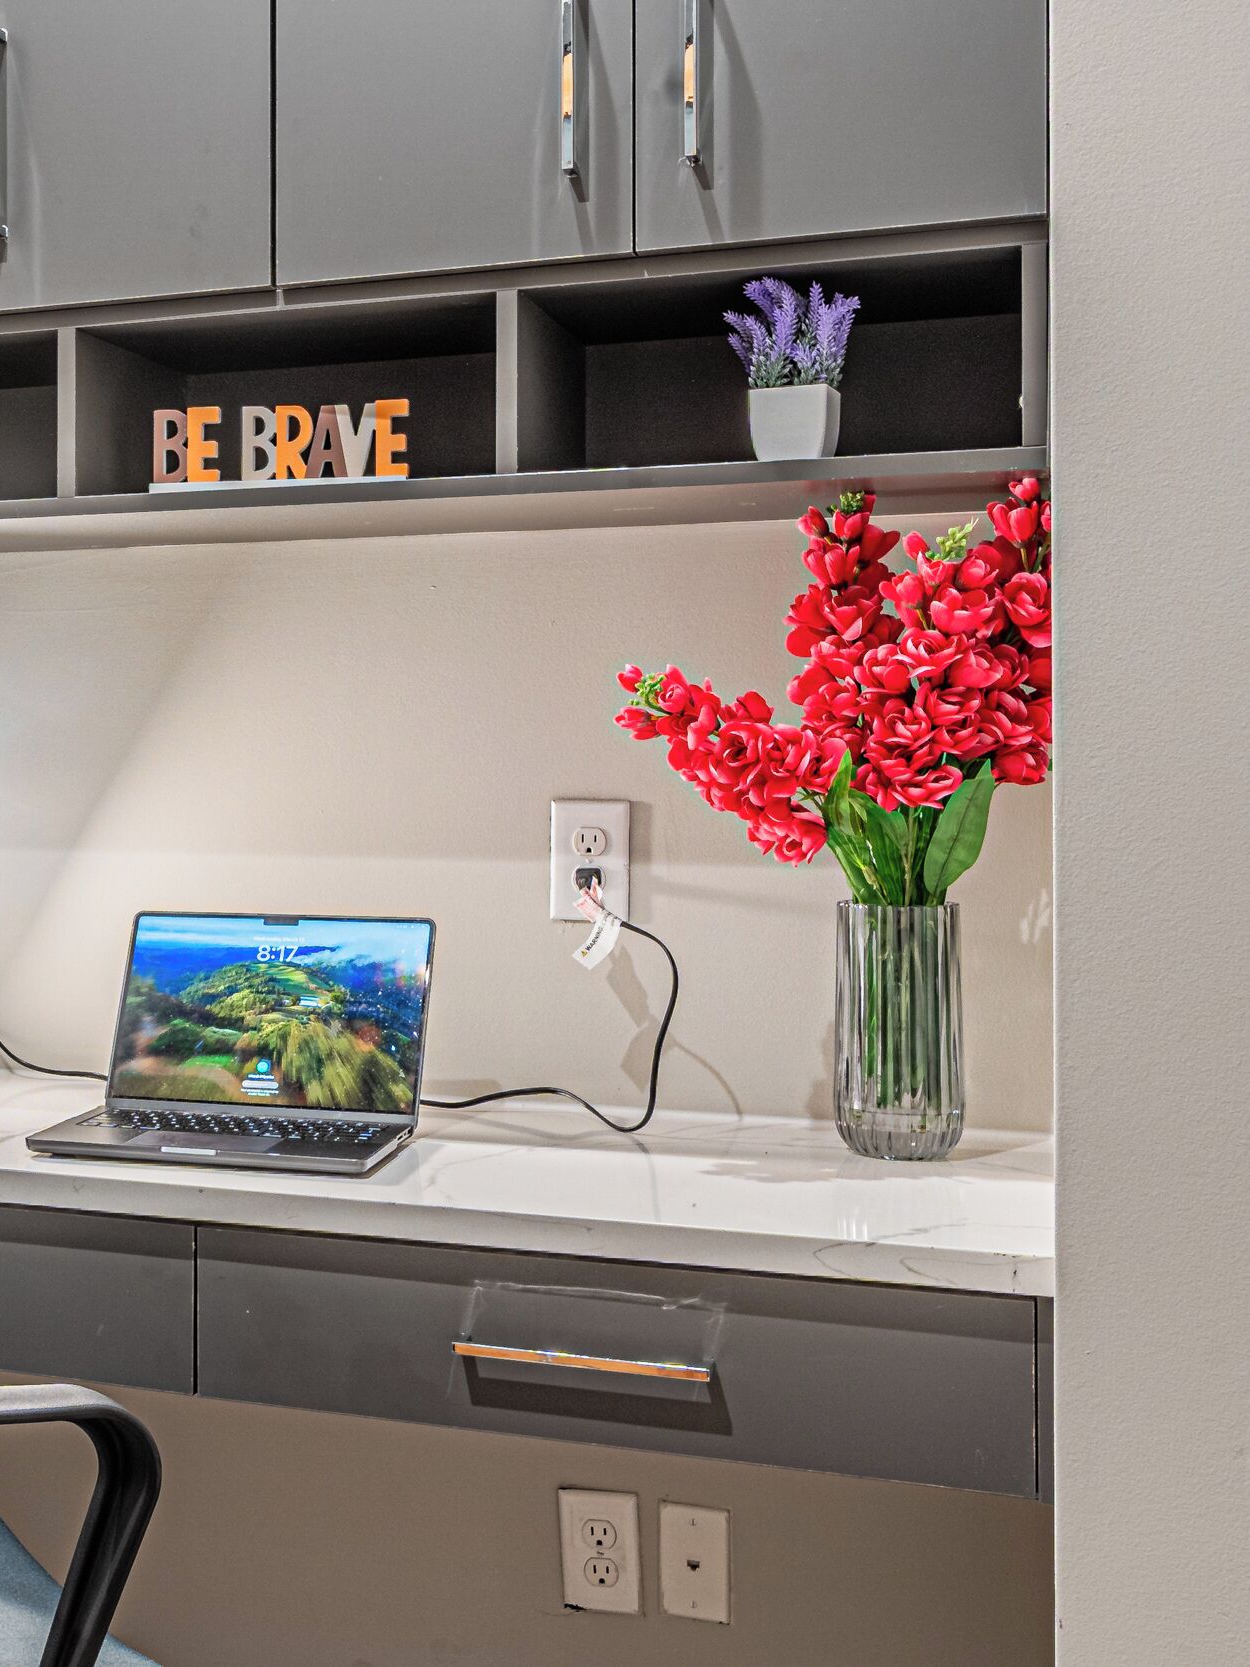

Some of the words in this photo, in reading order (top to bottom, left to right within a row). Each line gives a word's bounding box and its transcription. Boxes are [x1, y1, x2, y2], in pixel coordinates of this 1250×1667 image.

[153, 406, 221, 483] BE
[242, 399, 409, 480] BRAVE
[257, 944, 299, 962] 8:17
